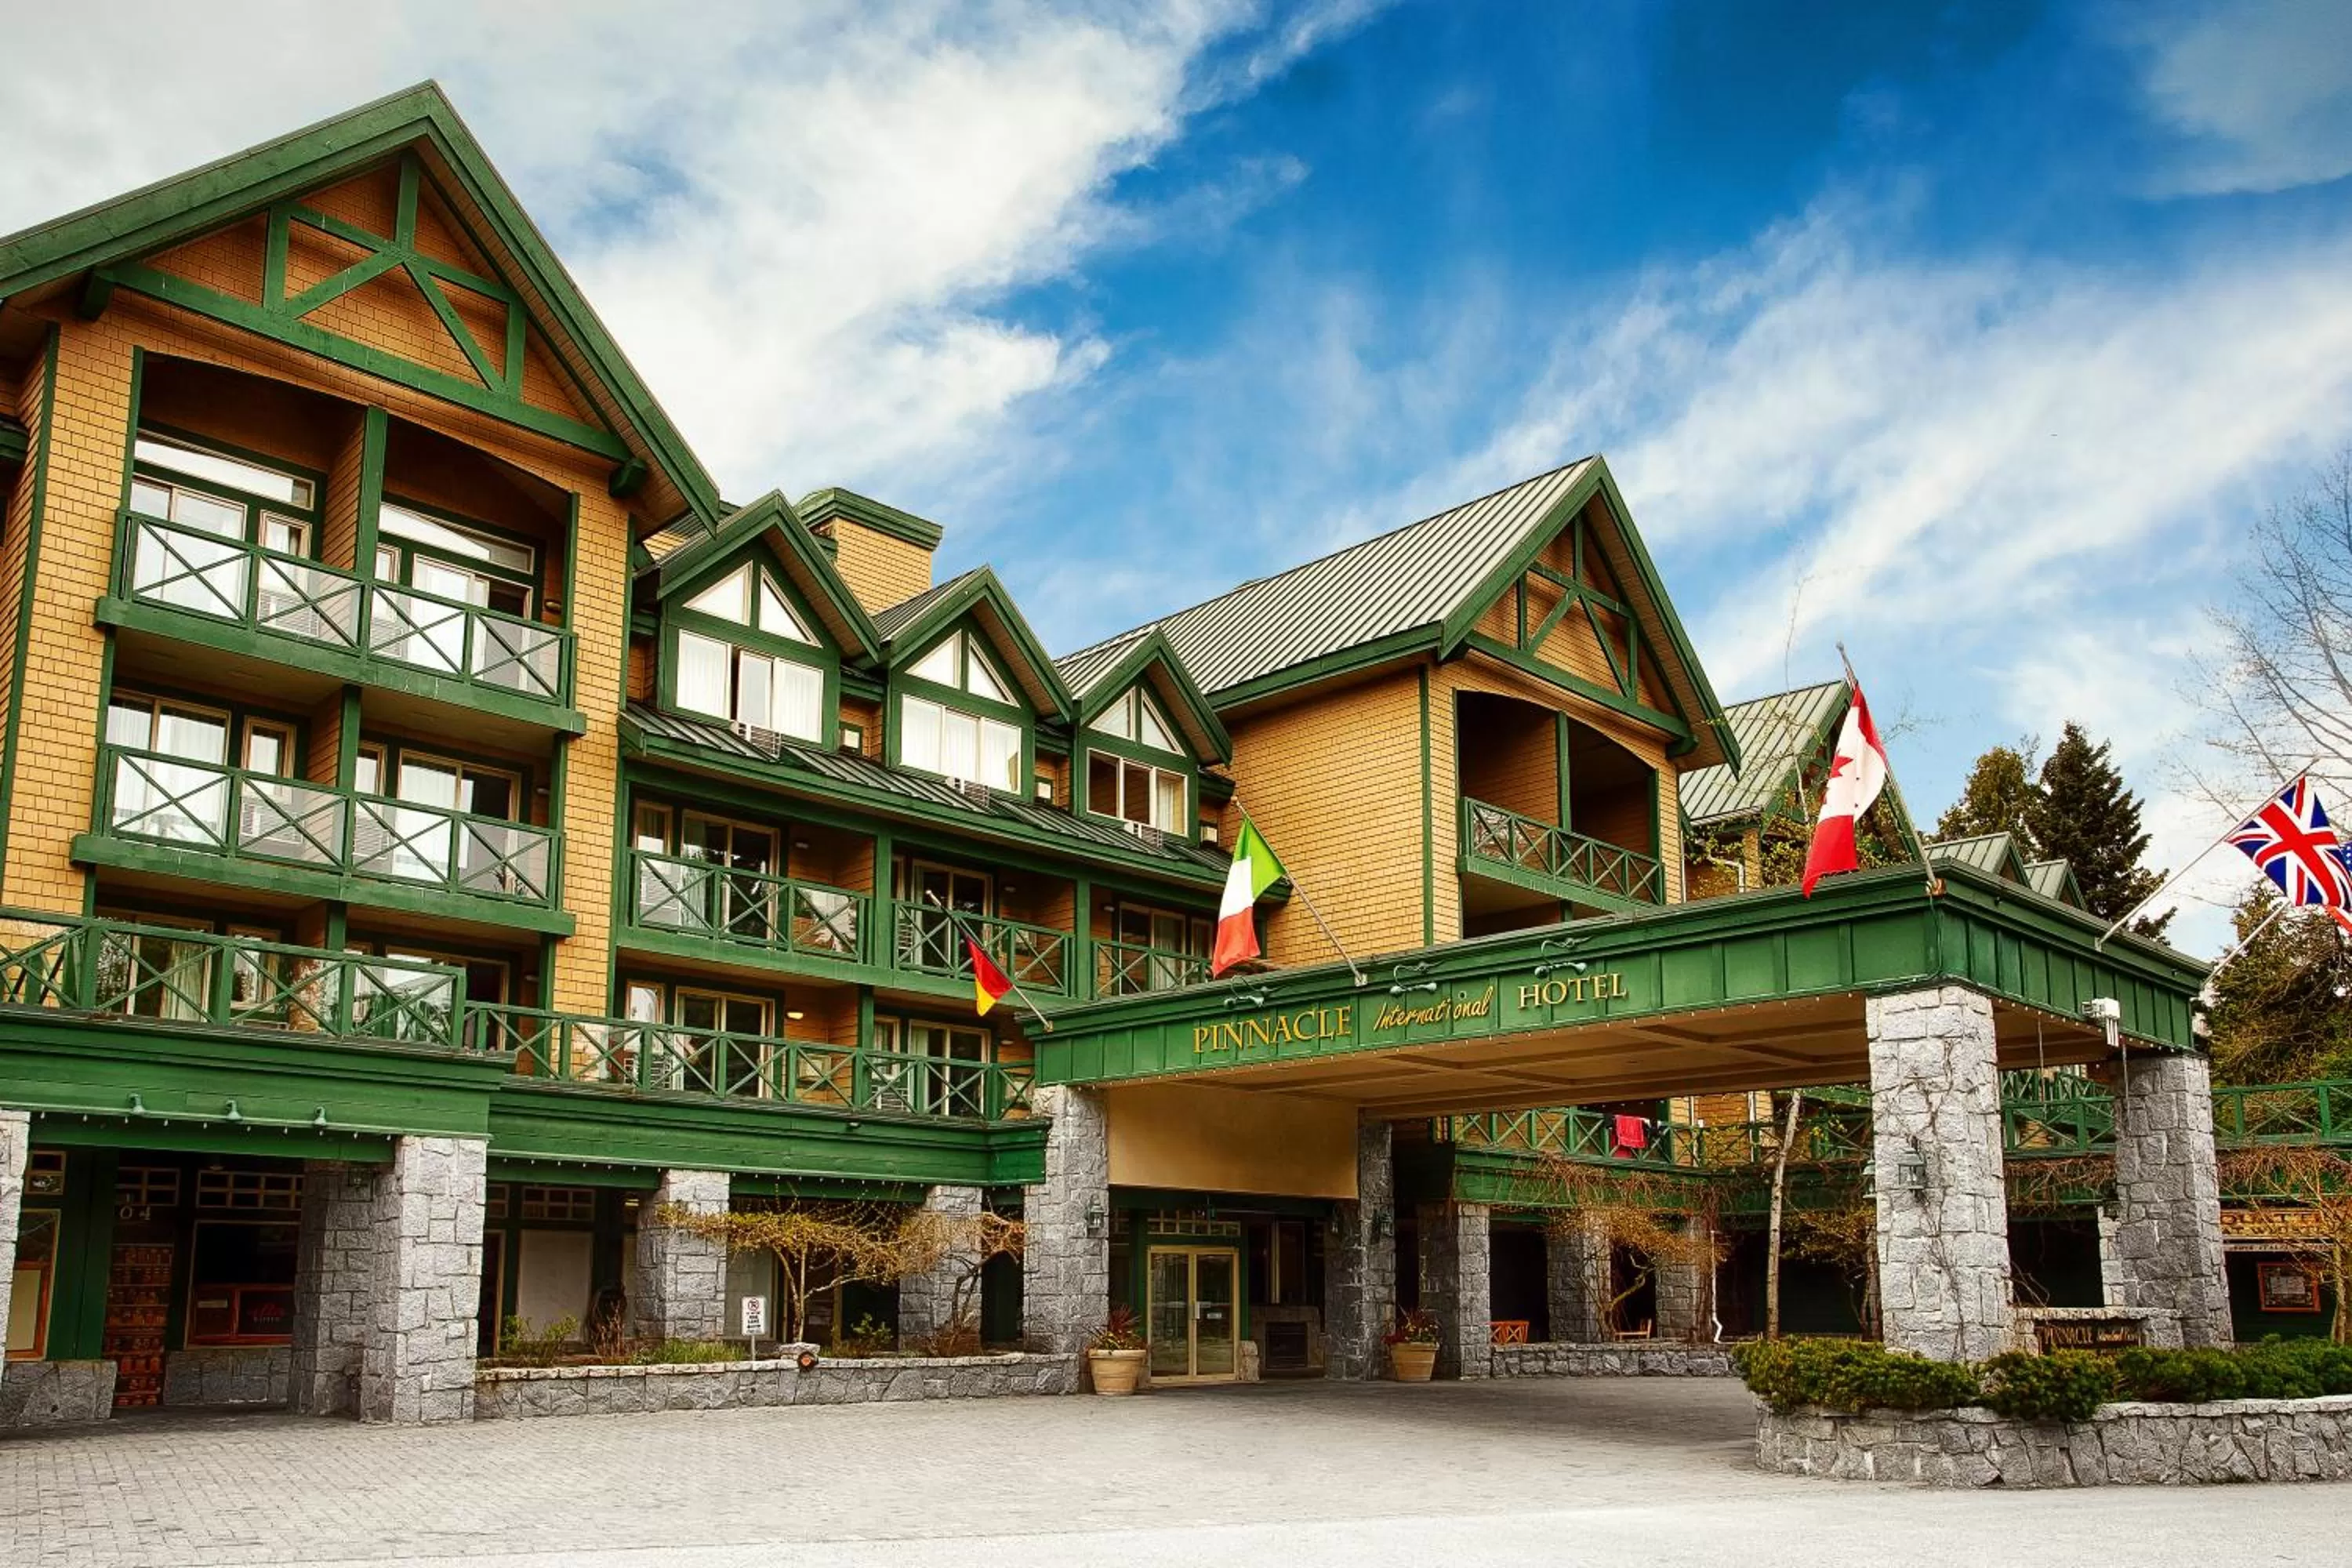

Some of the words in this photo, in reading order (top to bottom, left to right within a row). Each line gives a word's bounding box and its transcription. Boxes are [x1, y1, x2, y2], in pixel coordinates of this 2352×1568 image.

[1193, 1004, 1352, 1054] PINNACLE
[1373, 985, 1494, 1032] International
[1518, 972, 1627, 1010] HOTEL
